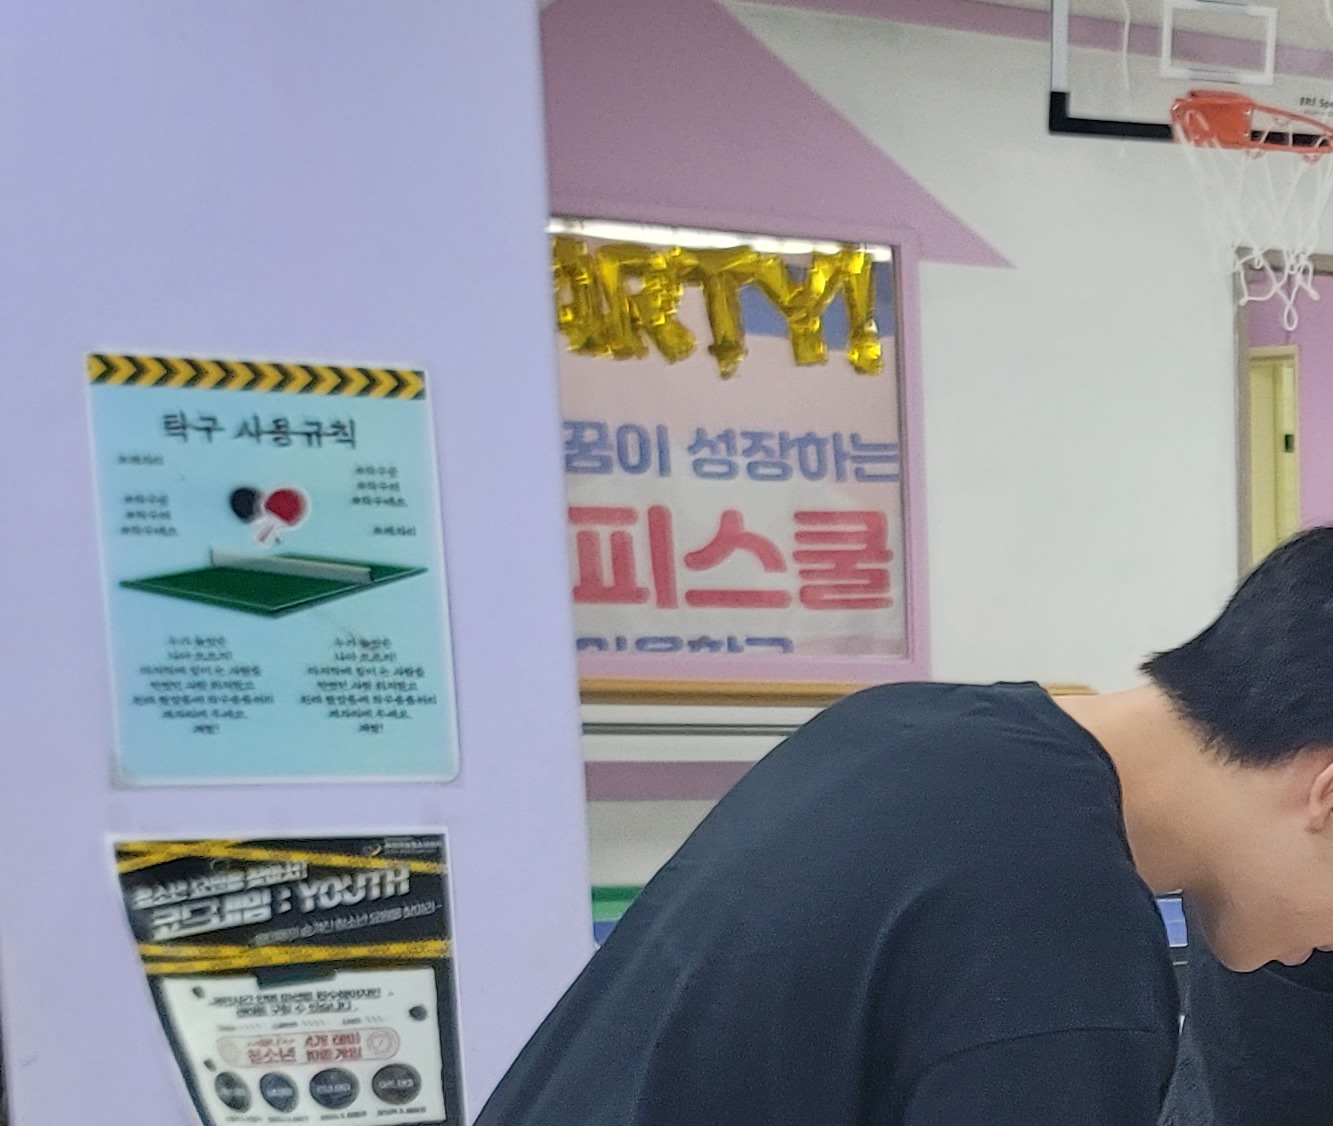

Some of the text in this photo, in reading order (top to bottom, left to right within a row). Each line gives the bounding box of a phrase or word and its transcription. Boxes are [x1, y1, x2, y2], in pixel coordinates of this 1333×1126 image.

[163, 409, 356, 450] 탁구 사용규칙
[563, 420, 899, 483] 꿈이 성장하는
[567, 505, 895, 611] 피스쿨
[298, 865, 410, 914] YOUTH
